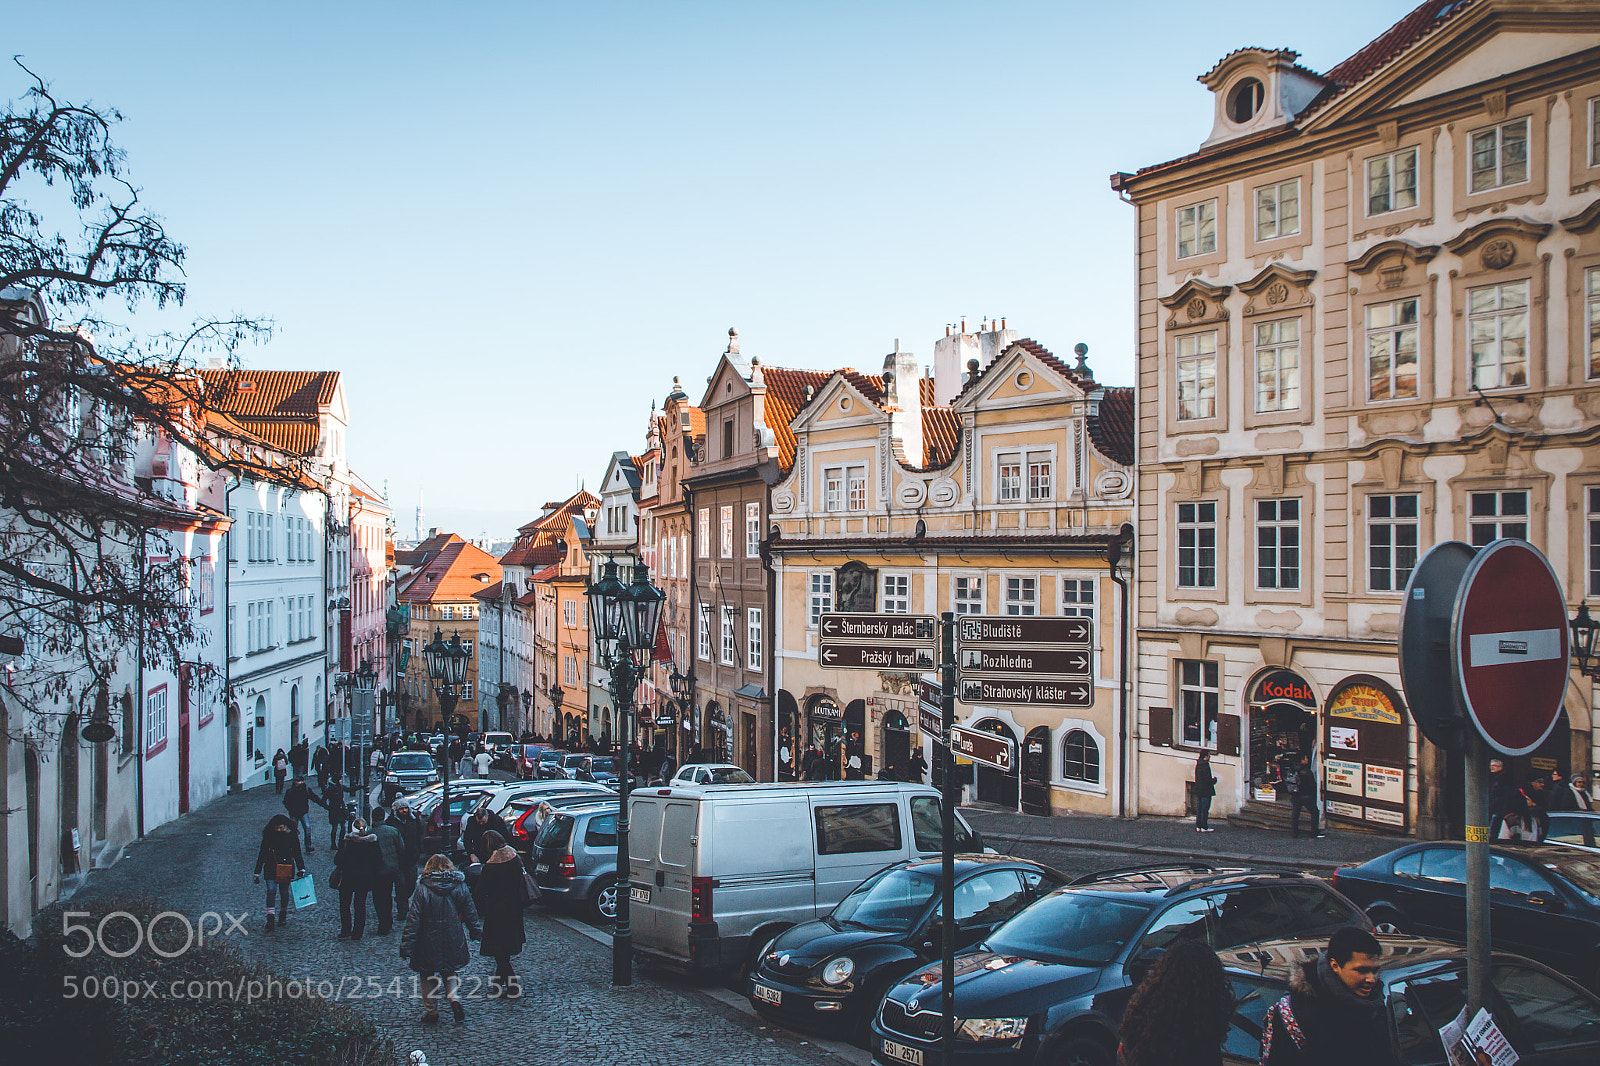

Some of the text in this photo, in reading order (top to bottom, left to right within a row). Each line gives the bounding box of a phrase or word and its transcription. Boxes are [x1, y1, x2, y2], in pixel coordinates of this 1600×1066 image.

[841, 618, 914, 637] Šternberský palác
[983, 623, 1022, 638] Bludiště
[861, 650, 914, 667] Pražský hrad
[983, 656, 1033, 669] Rozhledna
[983, 684, 1067, 701] Strahovský klášter
[1262, 681, 1313, 700] Kodak
[1351, 697, 1378, 707] SHOP
[961, 736, 974, 752] Loreta
[901, 1046, 920, 1063] 2571
